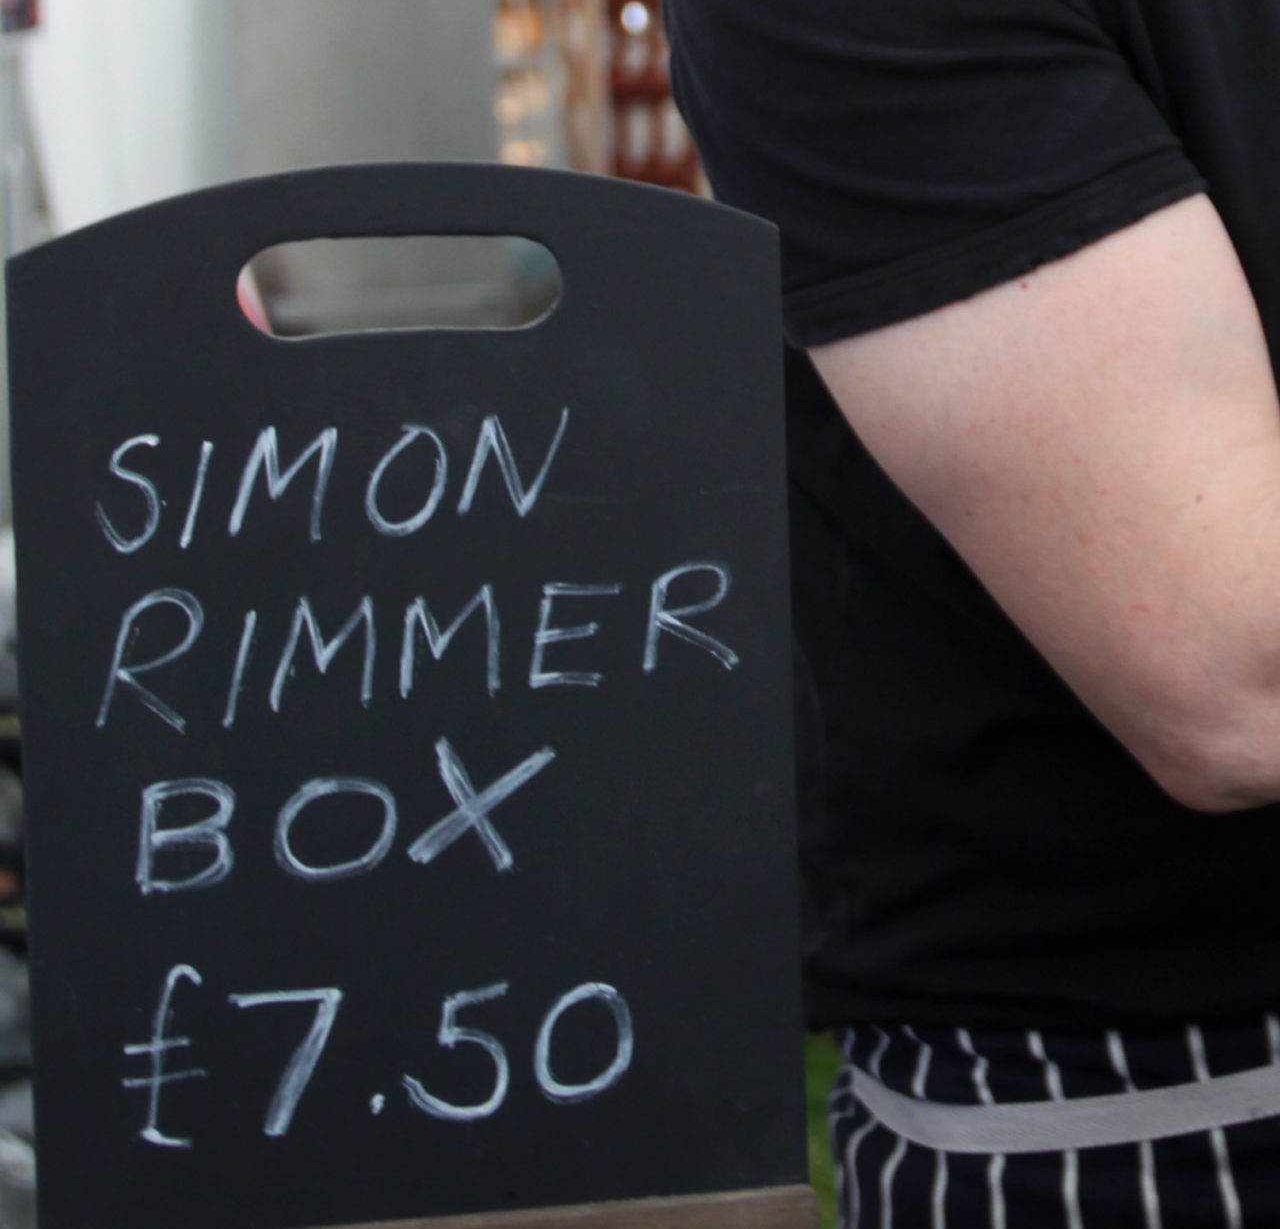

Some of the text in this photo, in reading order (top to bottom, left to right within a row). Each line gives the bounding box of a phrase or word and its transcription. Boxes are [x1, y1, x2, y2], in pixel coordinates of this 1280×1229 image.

[96, 407, 569, 553] SIMON
[96, 563, 740, 734] RIMMER
[136, 736, 556, 895] BOX
[122, 964, 633, 1149] £7.50
